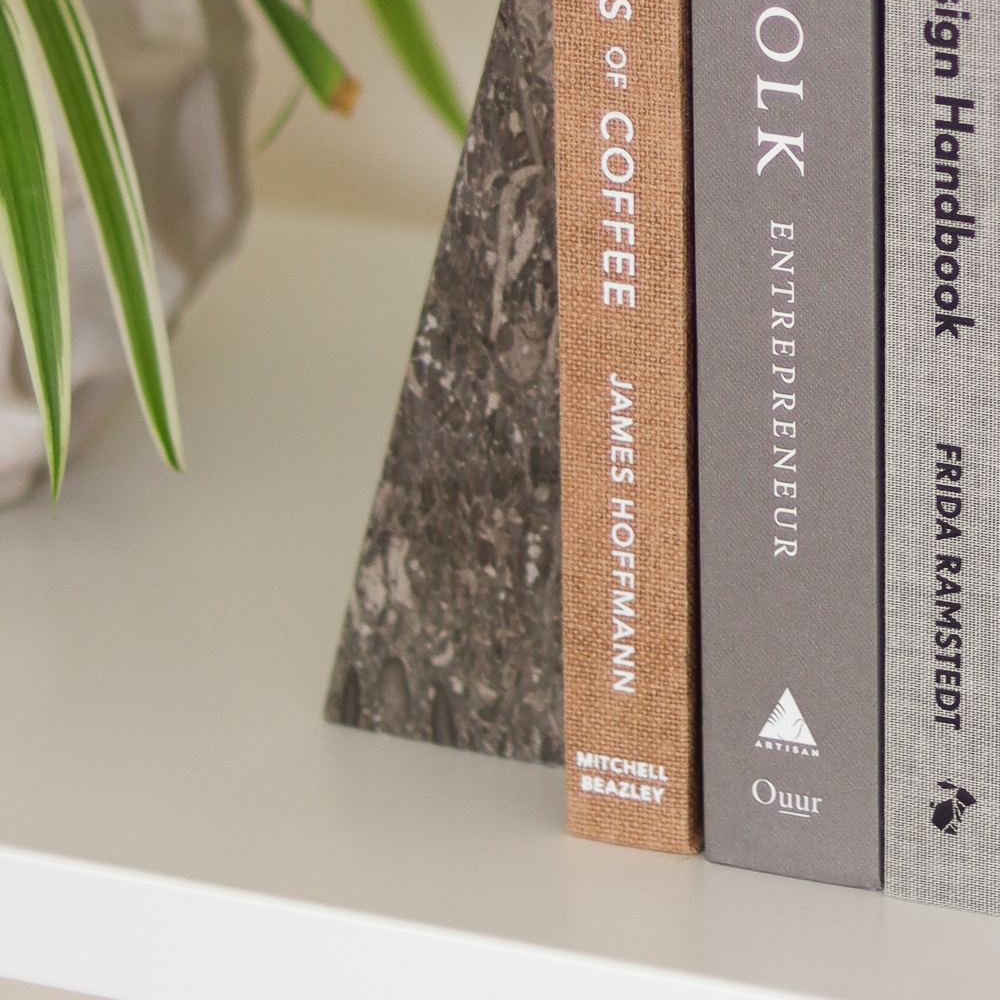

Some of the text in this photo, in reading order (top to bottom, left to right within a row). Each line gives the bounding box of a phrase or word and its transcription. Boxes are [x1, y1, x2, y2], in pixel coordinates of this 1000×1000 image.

[605, 46, 627, 90] OF
[601, 111, 636, 309] COFFEE
[933, 95, 976, 339] Handbook
[770, 219, 798, 557] ENTREPRENEUR
[609, 372, 636, 694] JAMES HOFFMANN
[934, 443, 963, 731] FRIDA RAMSTEDT
[576, 750, 669, 782] MITCHELL
[580, 775, 665, 804] BEAZLEY
[751, 778, 823, 818] Ouur
[754, 740, 820, 757] ARTISAN
